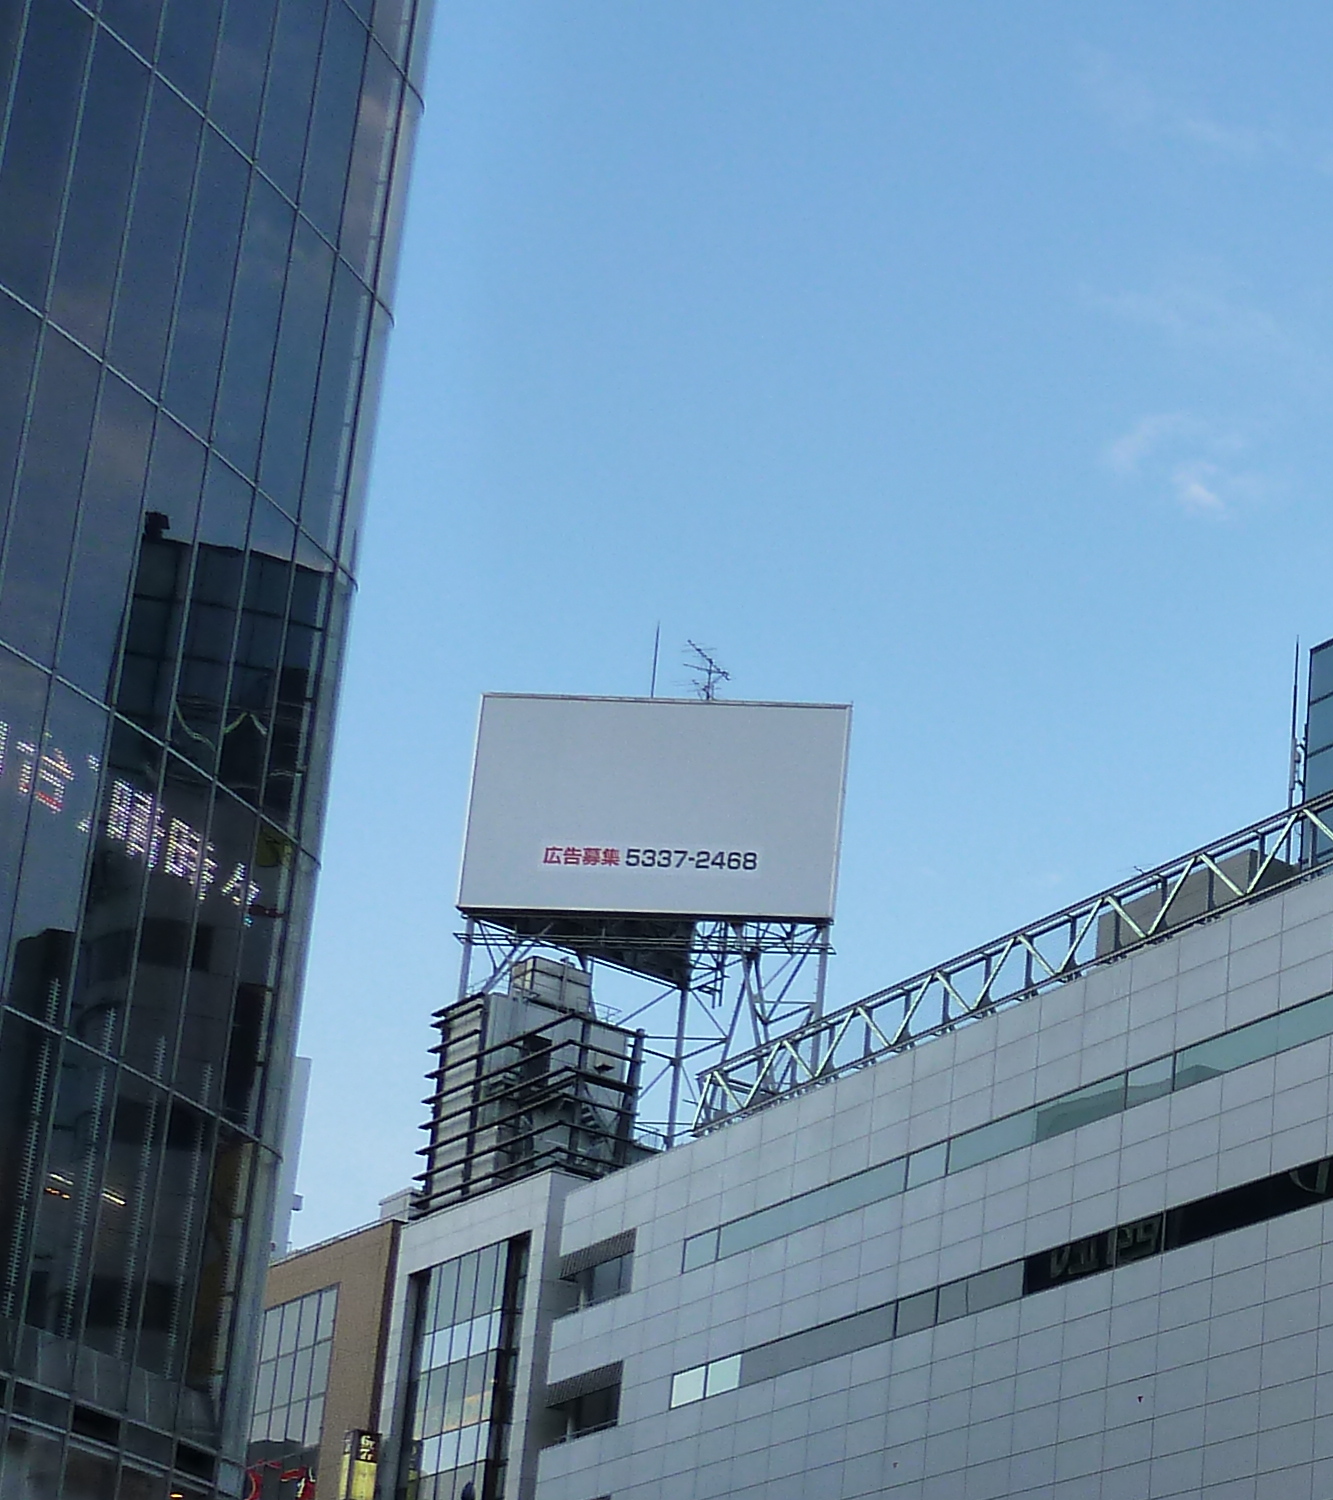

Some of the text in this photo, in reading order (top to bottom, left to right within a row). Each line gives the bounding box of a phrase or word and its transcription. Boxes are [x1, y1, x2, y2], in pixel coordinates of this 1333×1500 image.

[542, 846, 758, 871] 広告募集 5337-2468
